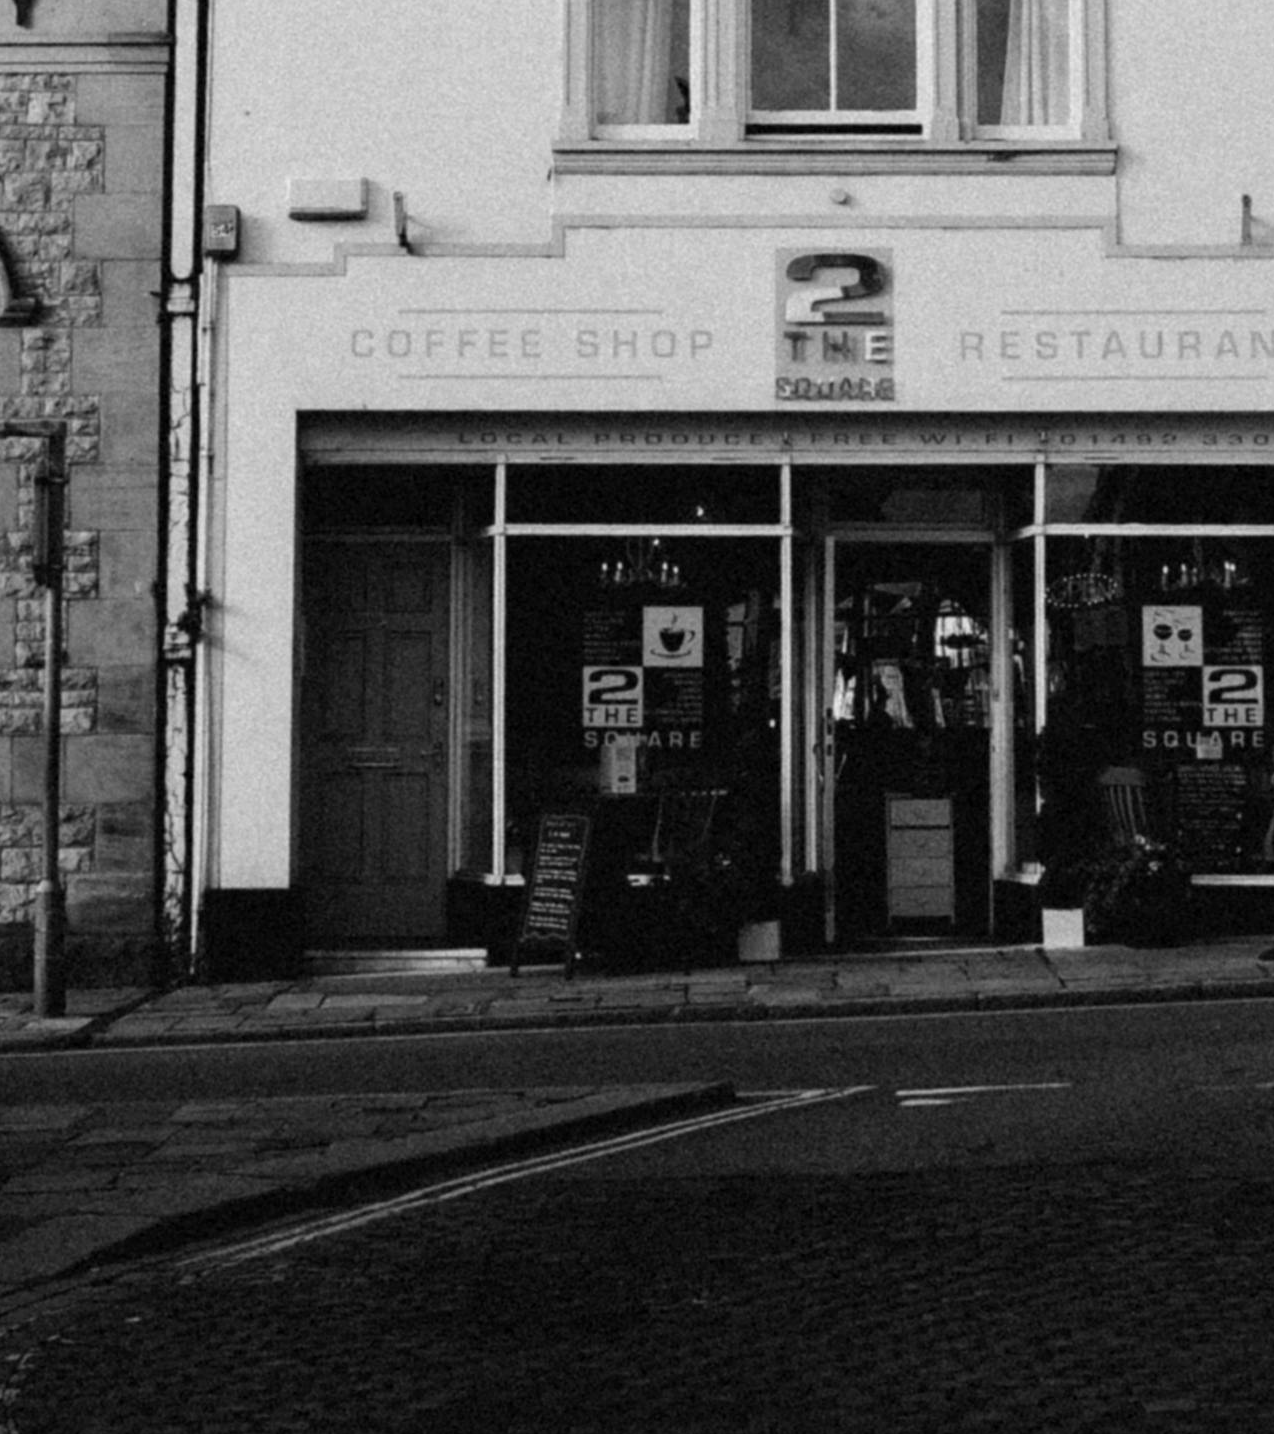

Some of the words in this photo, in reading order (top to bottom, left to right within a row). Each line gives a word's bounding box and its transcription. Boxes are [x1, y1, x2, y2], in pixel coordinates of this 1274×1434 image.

[785, 253, 892, 327] 2
[350, 329, 542, 358] COFFEE
[576, 329, 714, 358] SHOP
[783, 330, 894, 365] THE
[775, 376, 895, 401] SQUARE
[457, 431, 572, 445] LOCAL
[594, 431, 764, 445] PRODUCE
[810, 432, 897, 446] FREE
[589, 669, 639, 705] 2
[1208, 668, 1259, 704] 2
[586, 707, 640, 724] THE
[1206, 707, 1259, 724] THE
[1142, 729, 1266, 749] SQUARE
